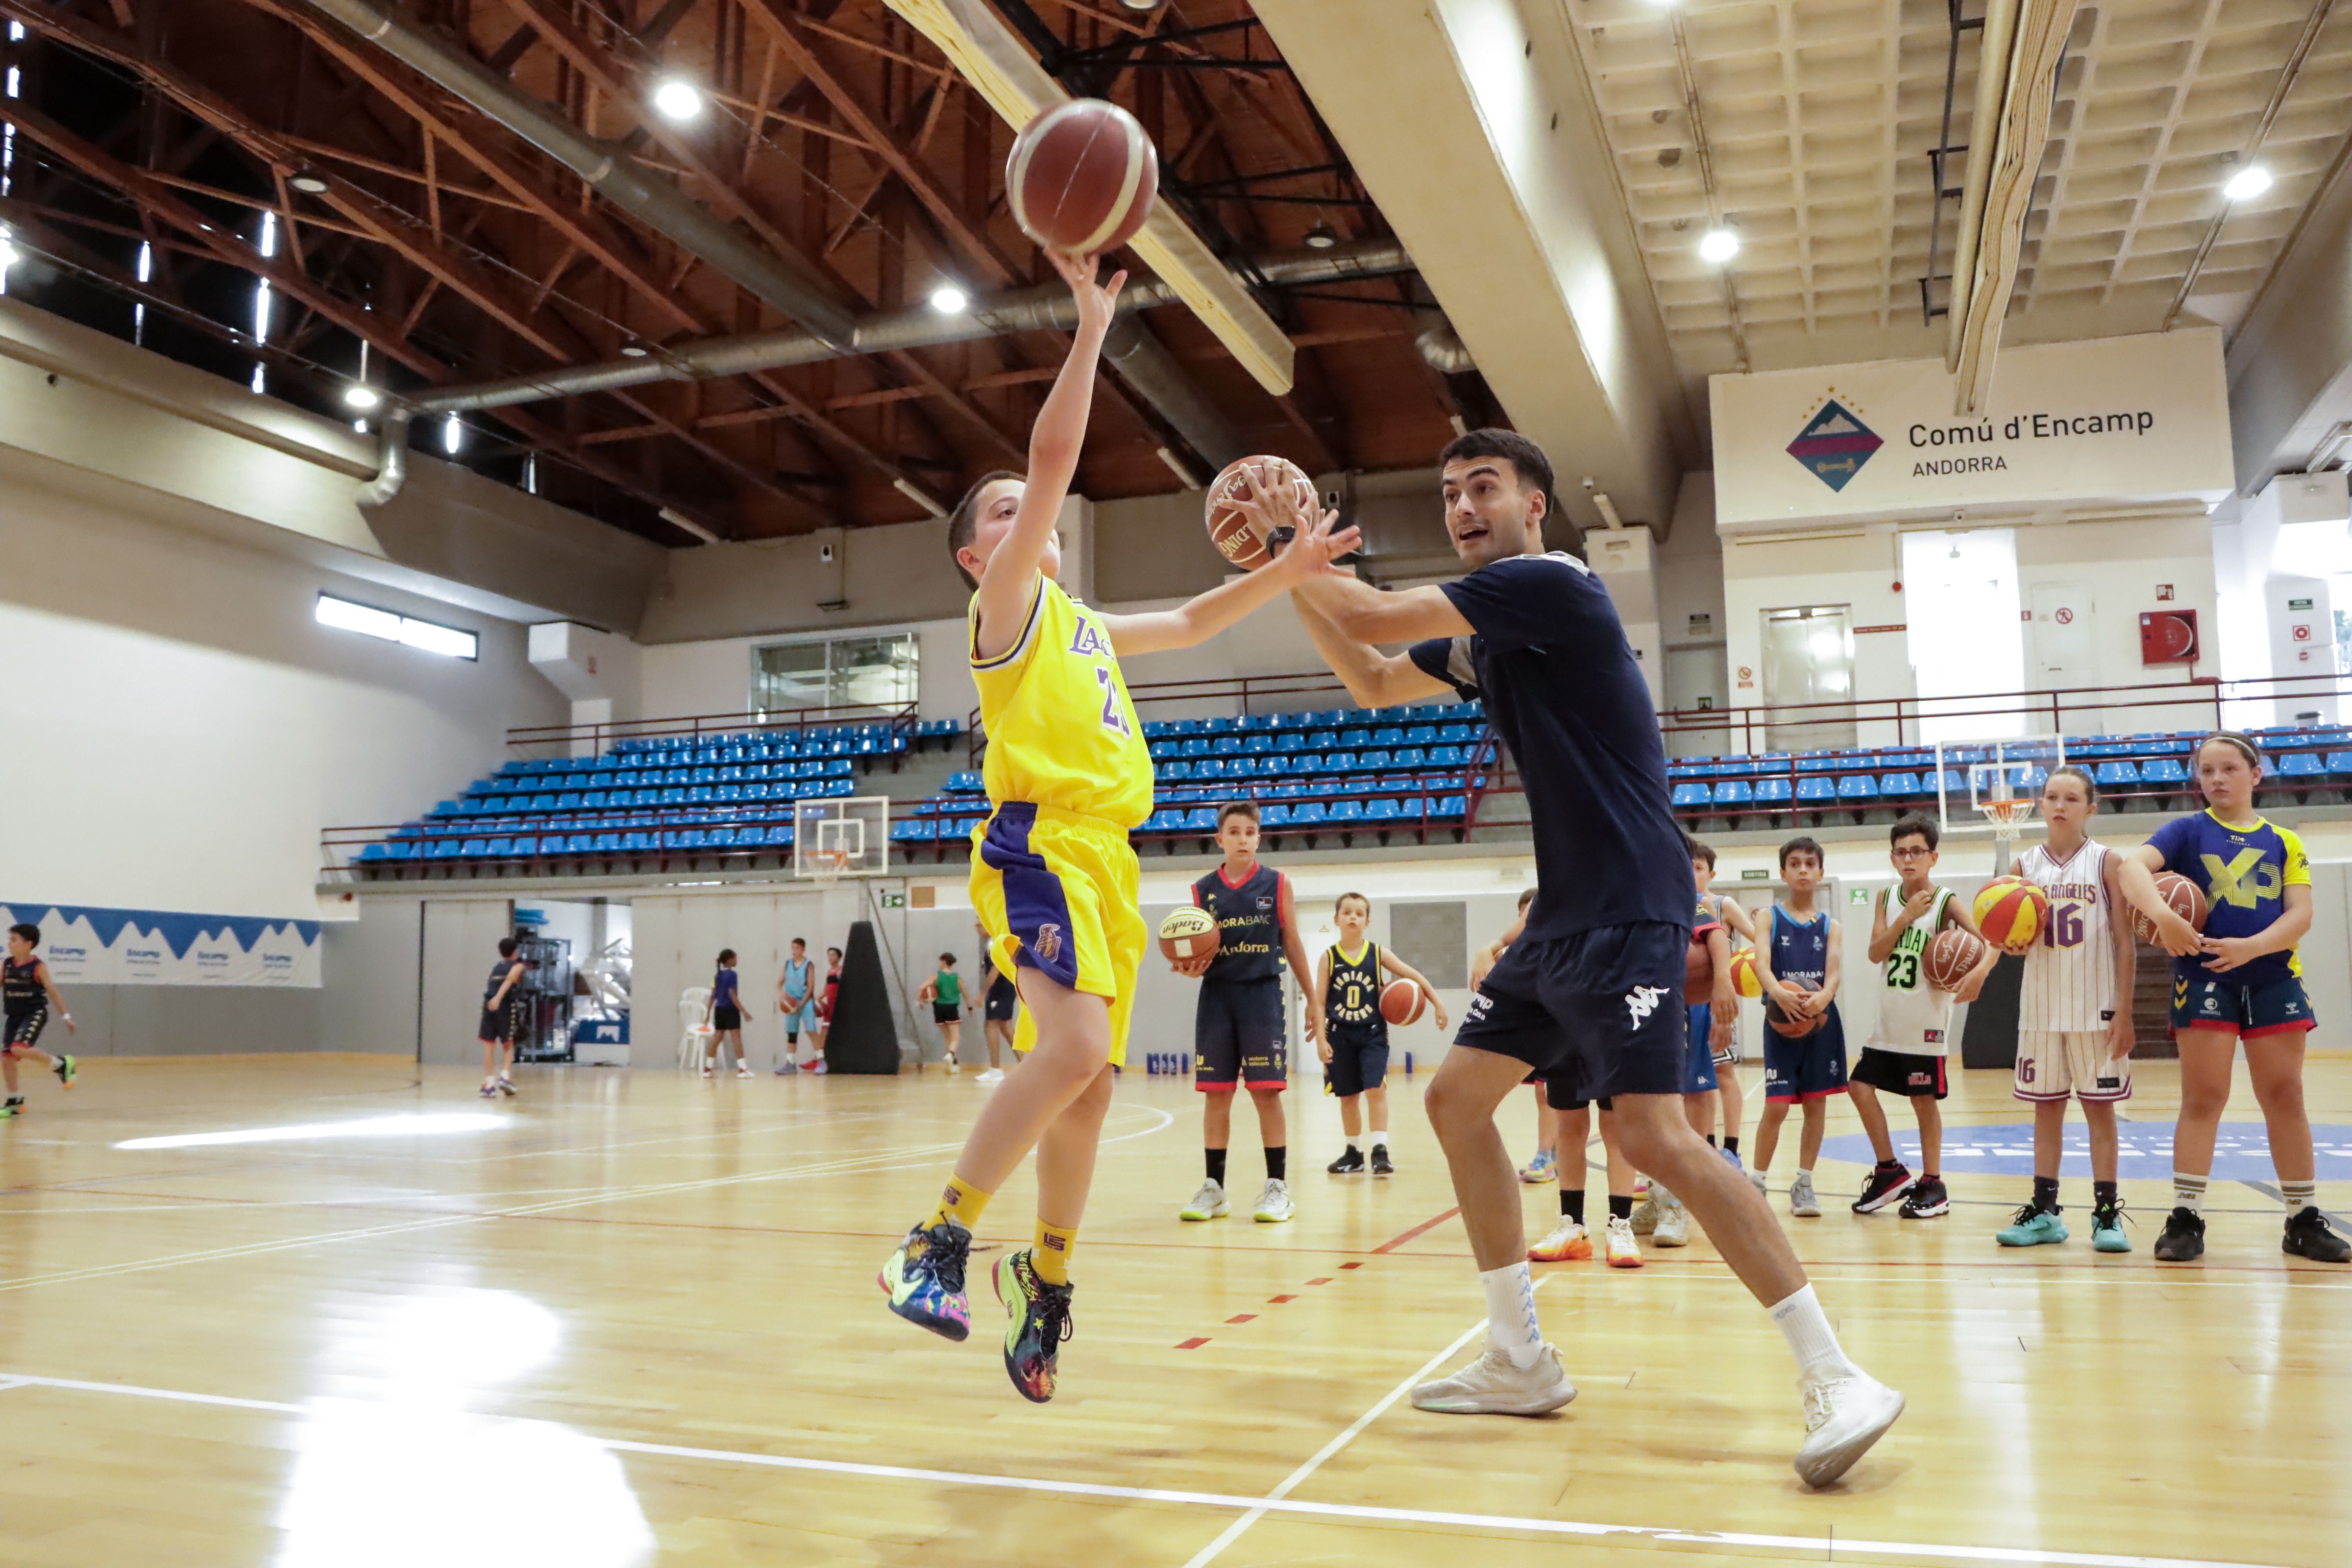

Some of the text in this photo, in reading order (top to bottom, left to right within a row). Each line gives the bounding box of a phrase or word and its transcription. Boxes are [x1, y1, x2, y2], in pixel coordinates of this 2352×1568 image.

[1910, 411, 2154, 447] Comú d'Encamp
[1912, 456, 2008, 477] ANDORRA
[1218, 521, 1250, 558] LDING
[2051, 883, 2097, 905] ANGELES
[1163, 920, 1204, 933] Baden
[2044, 902, 2083, 948] 16
[1219, 941, 1270, 956] Andorra
[1333, 970, 1374, 992] INDIANA
[1887, 954, 1917, 989] 23
[1347, 985, 1360, 1008] 0
[1334, 1003, 1373, 1021] PACERS
[2018, 1056, 2035, 1084] 16
